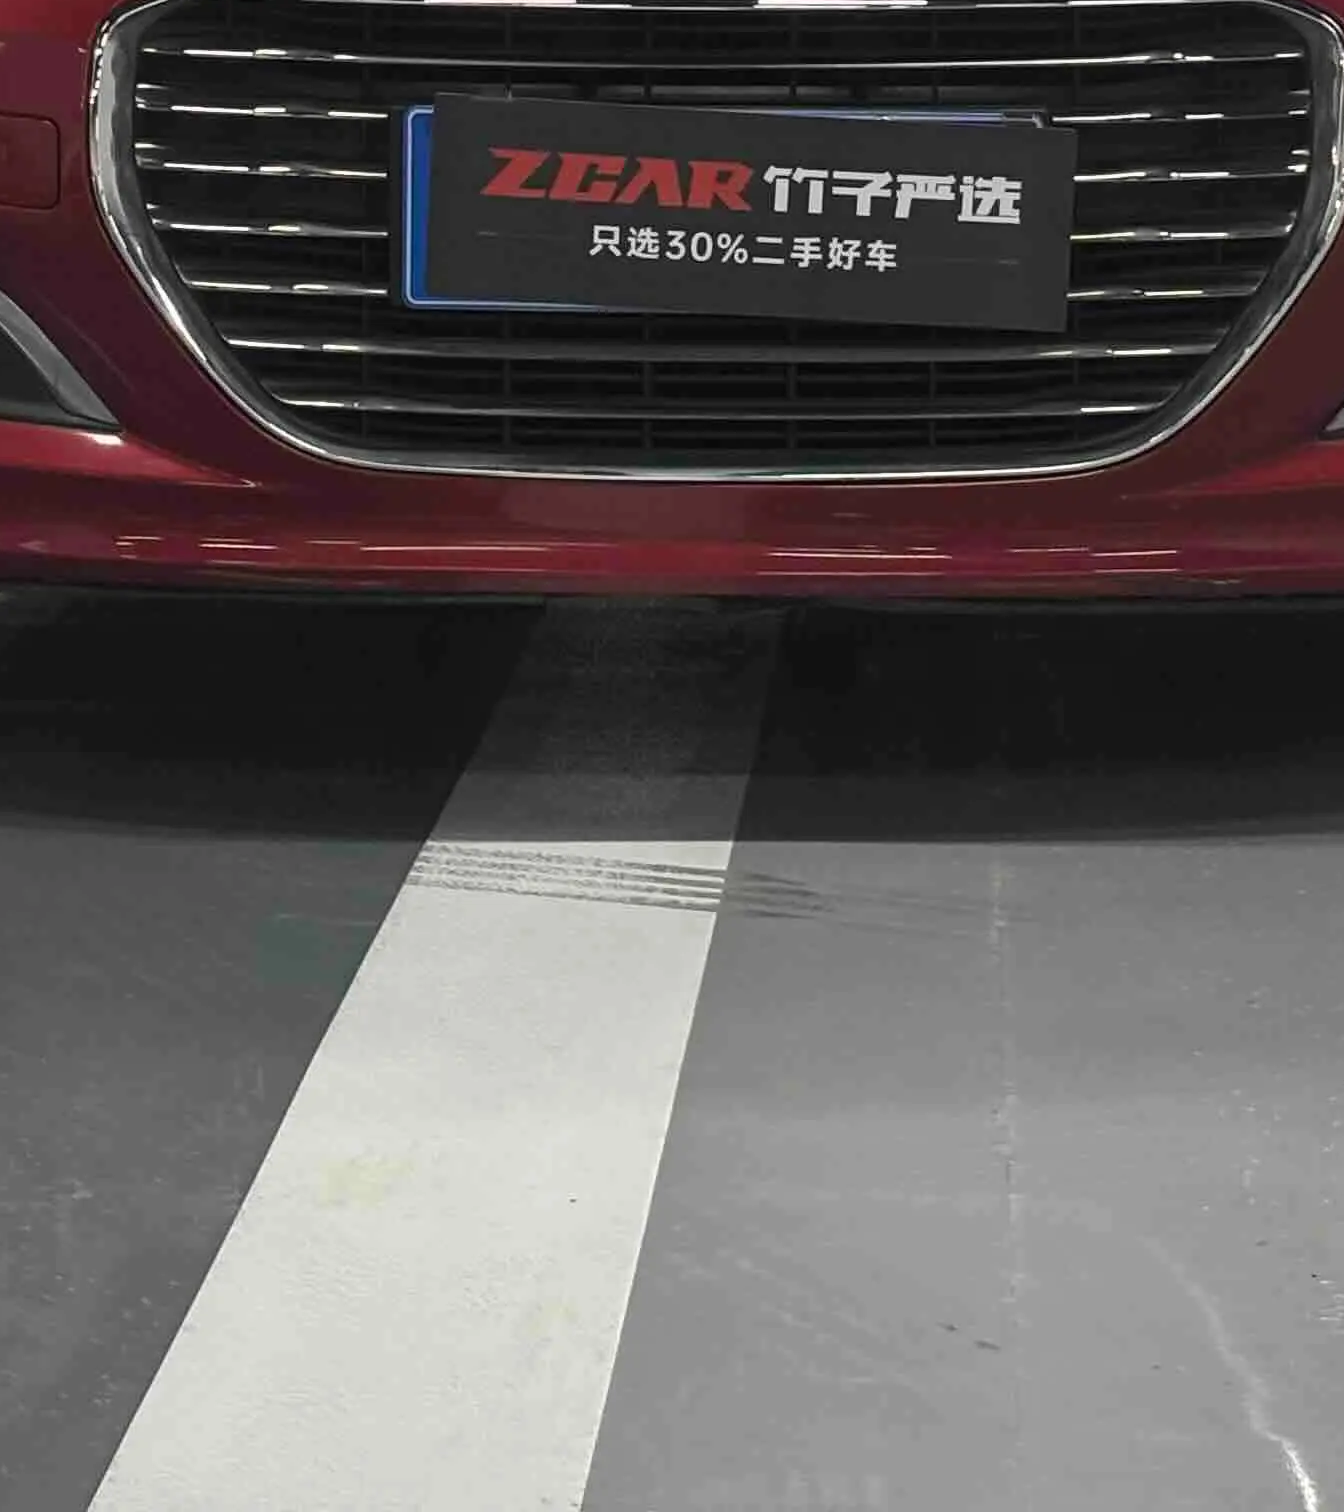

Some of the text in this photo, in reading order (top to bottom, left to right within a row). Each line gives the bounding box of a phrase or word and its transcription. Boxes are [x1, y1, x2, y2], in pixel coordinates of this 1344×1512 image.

[762, 164, 1023, 224] 竹子严选
[588, 223, 897, 273] 只选30%二手好车
